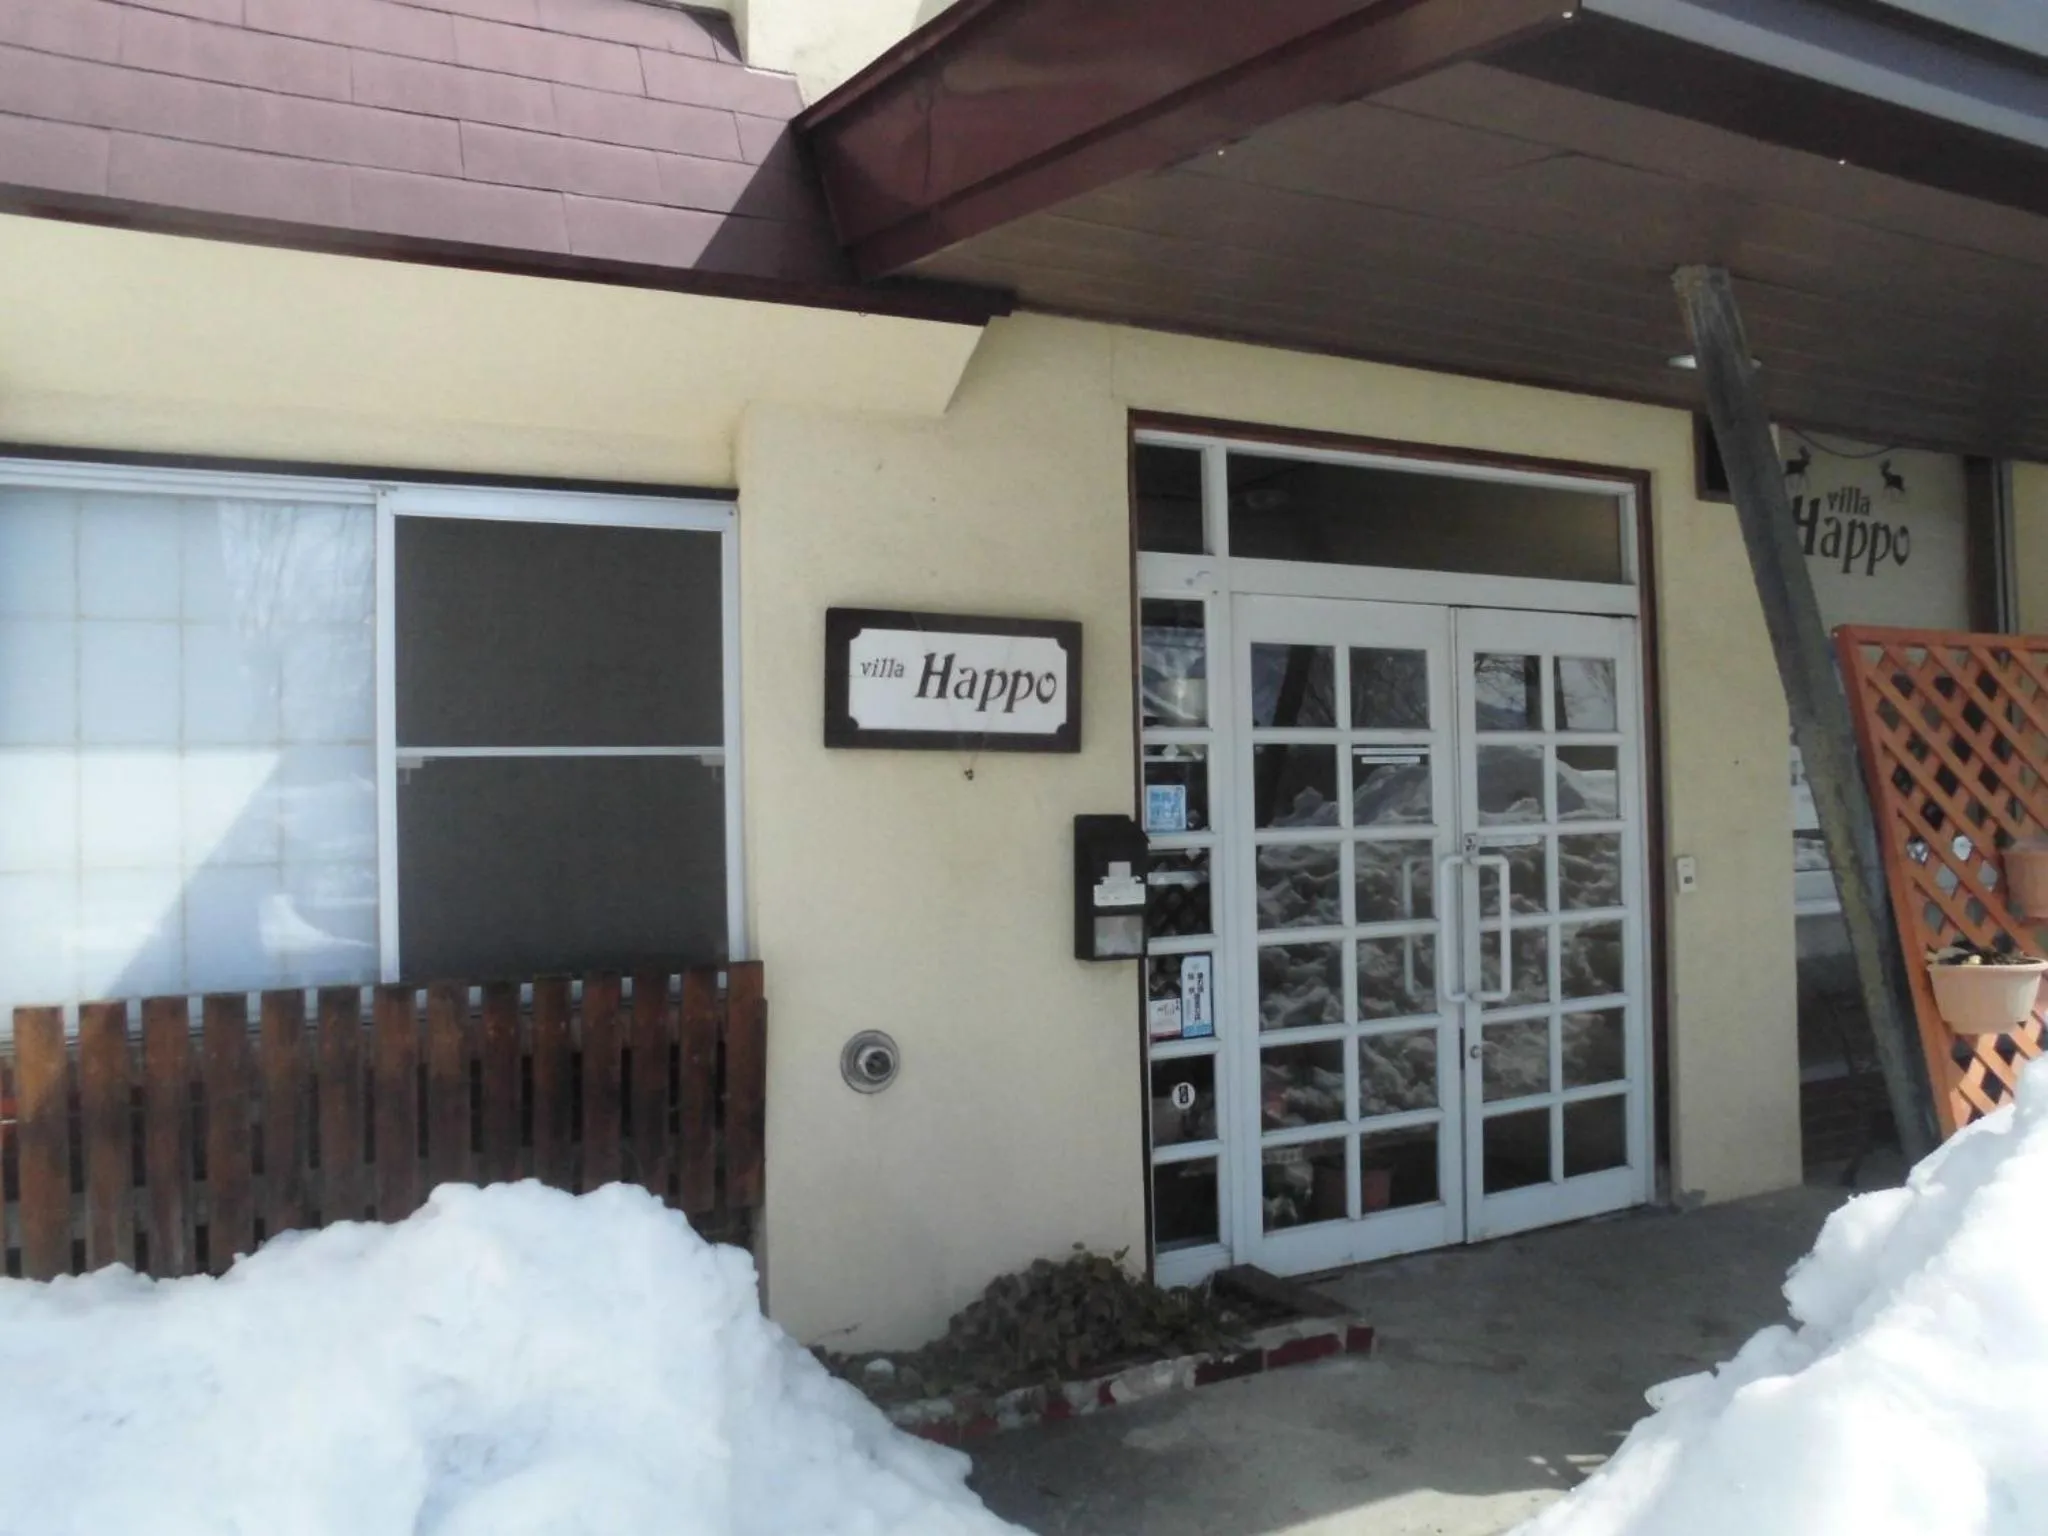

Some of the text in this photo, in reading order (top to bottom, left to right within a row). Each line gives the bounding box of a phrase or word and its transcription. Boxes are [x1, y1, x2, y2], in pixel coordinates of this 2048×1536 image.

[1827, 486, 1871, 516] villa
[860, 652, 1057, 713] villa Happo
